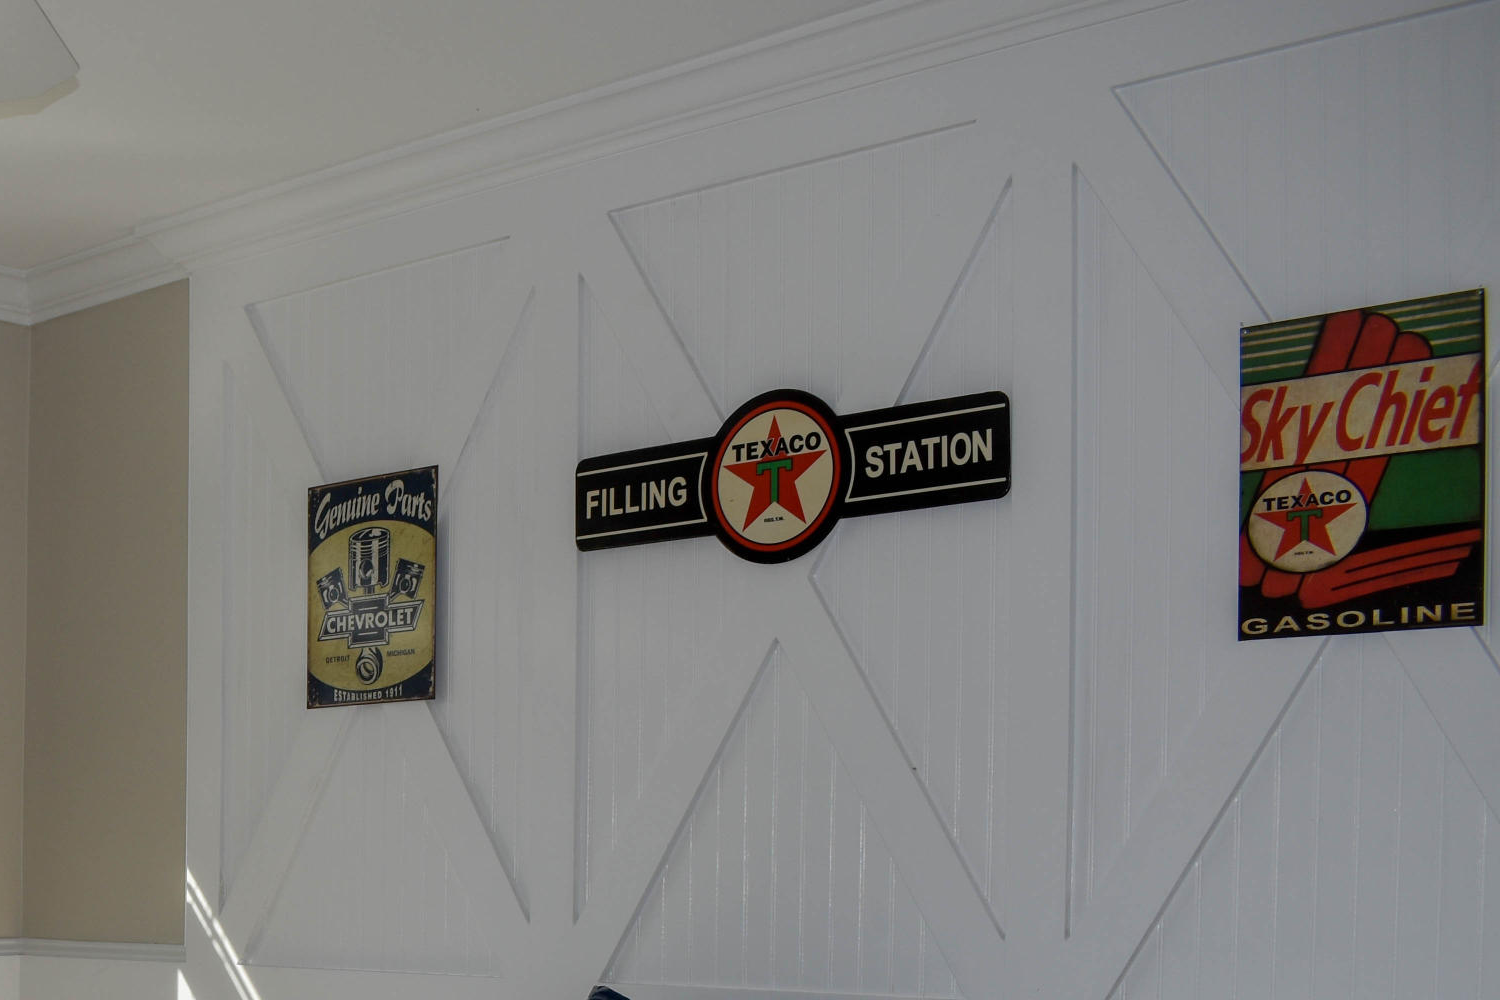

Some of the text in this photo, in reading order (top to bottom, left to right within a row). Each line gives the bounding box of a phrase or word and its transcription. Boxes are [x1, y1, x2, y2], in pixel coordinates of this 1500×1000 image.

[1241, 358, 1481, 465] Sky Chief
[731, 432, 822, 462] TEXACO
[864, 428, 993, 478] STATION
[314, 479, 432, 540] Genuine Parts
[585, 476, 688, 519] FILLING
[1262, 489, 1352, 512] TEXACO
[326, 607, 414, 634] CHEVROLET
[1241, 602, 1476, 635] GASOLINE
[325, 654, 350, 664] DETROIT
[386, 647, 416, 657] MICHIGAN
[333, 684, 403, 702] ESTABLISHED 1911
